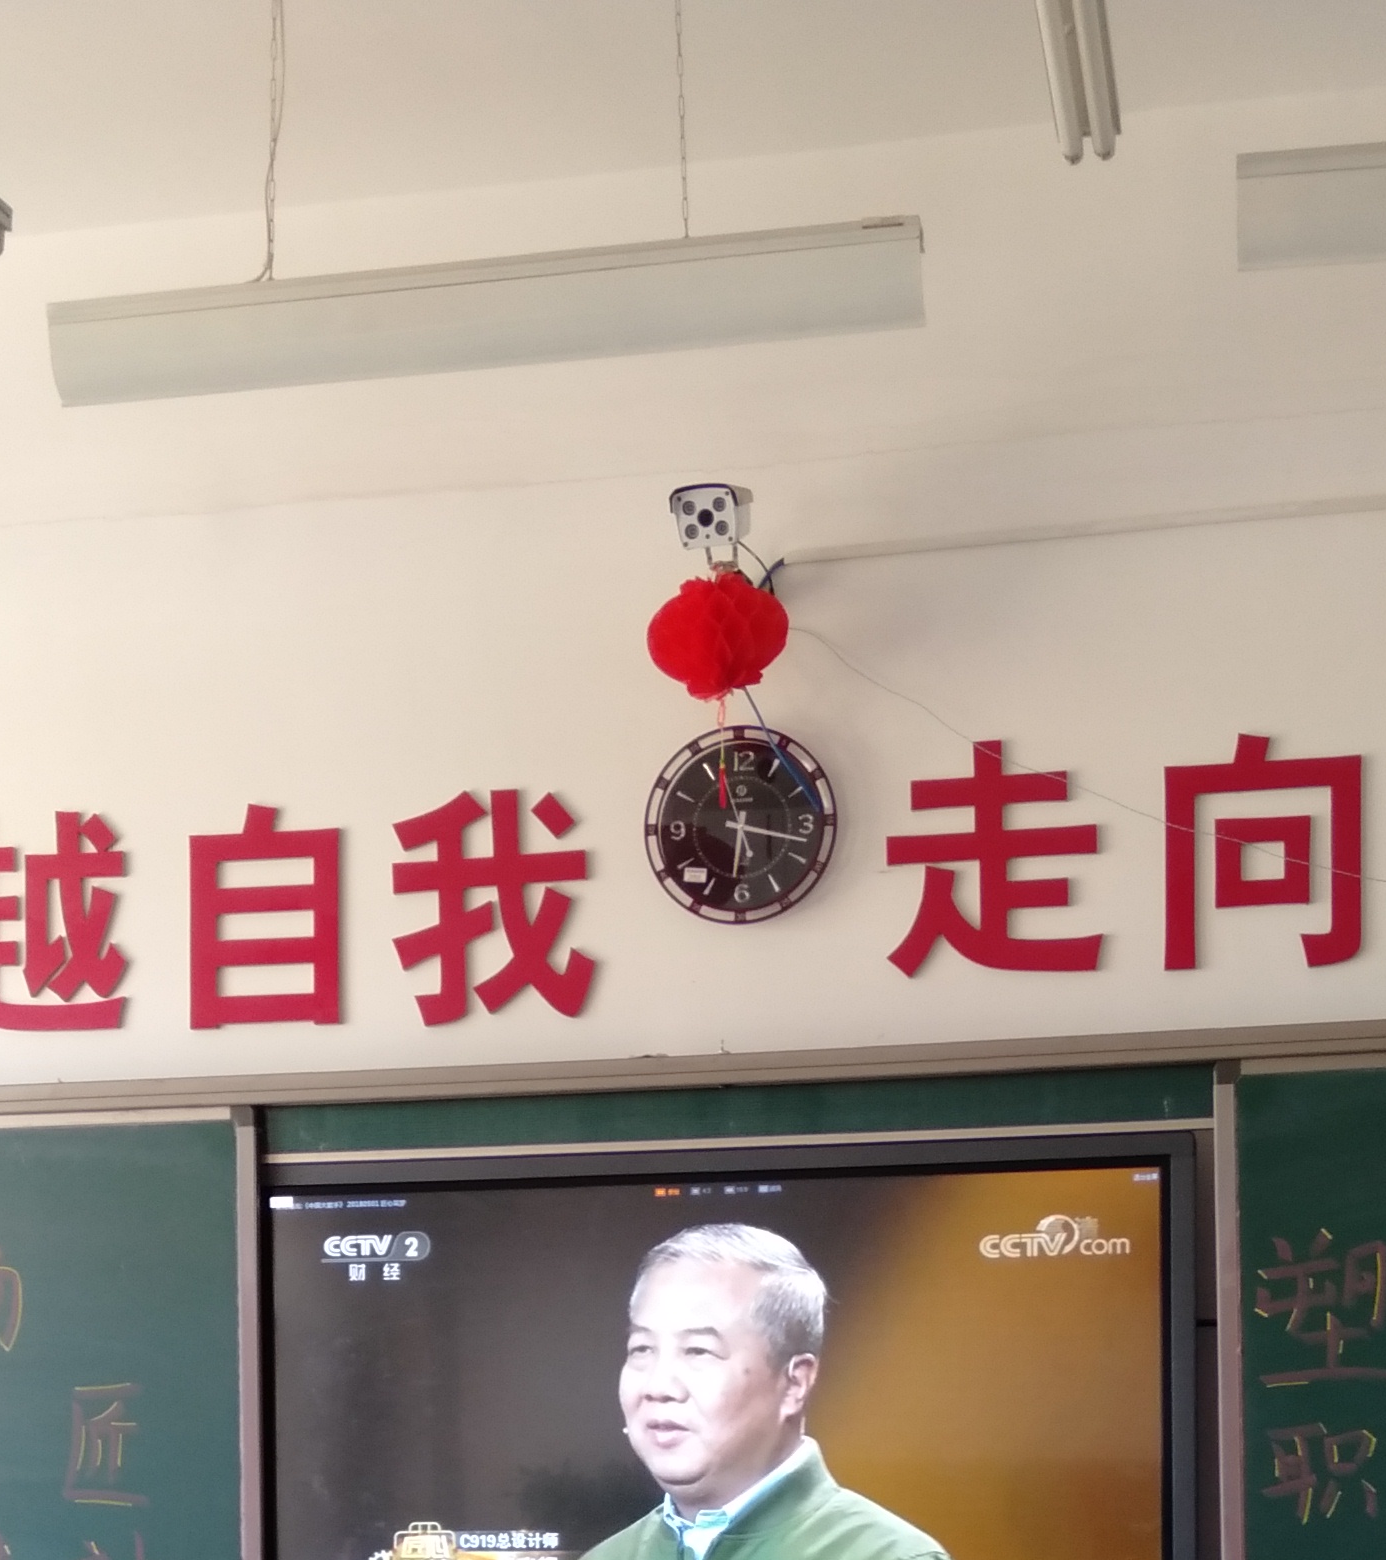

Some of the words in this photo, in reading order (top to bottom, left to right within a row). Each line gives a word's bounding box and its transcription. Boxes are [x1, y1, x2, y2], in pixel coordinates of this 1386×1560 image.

[733, 751, 755, 772] 12
[669, 820, 686, 841] 9
[798, 813, 813, 835] 3
[733, 883, 750, 903] 6
[323, 1234, 393, 1257] CCTV
[348, 1262, 401, 1281] 财经
[459, 1532, 559, 1549] C919总设计师
